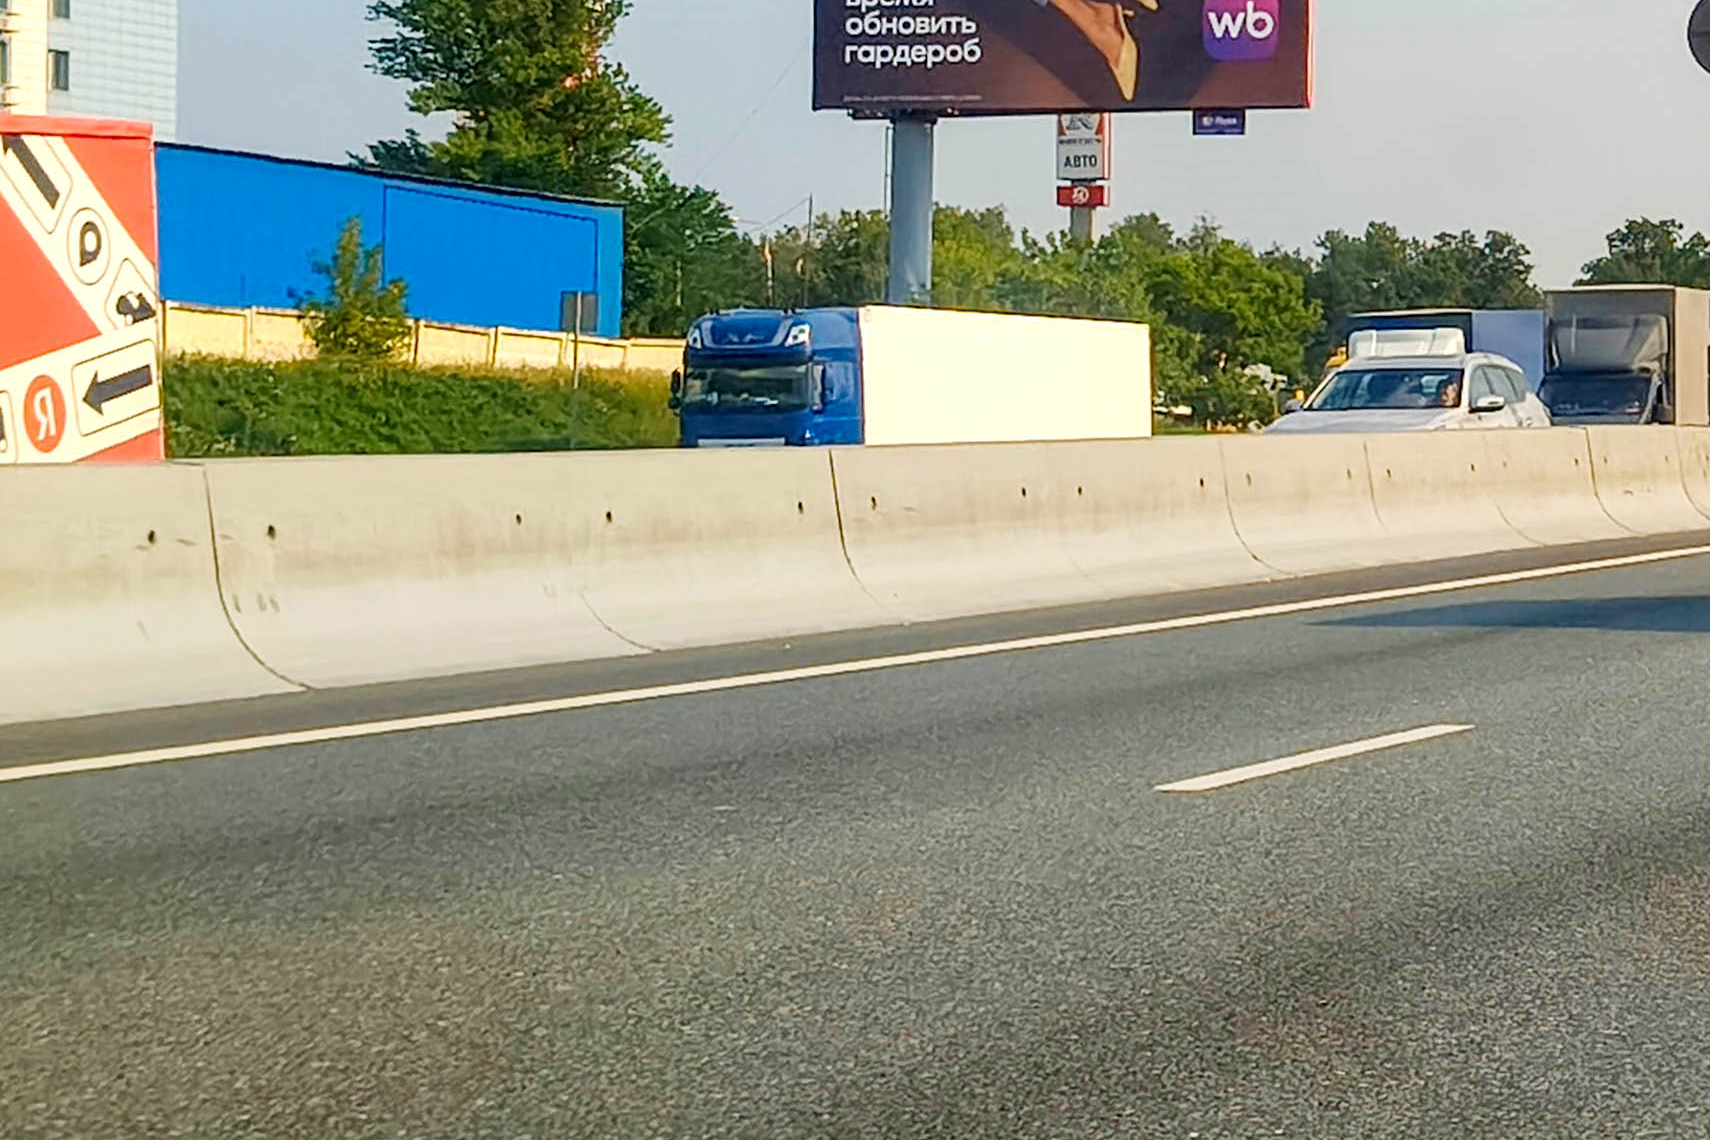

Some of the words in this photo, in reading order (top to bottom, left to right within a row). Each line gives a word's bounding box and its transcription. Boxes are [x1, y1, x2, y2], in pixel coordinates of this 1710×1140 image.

[845, 10, 977, 35] обновить
[1207, 0, 1274, 39] wb
[844, 38, 982, 69] гардероб
[1064, 154, 1098, 168] АВТО
[33, 388, 56, 441] Я
